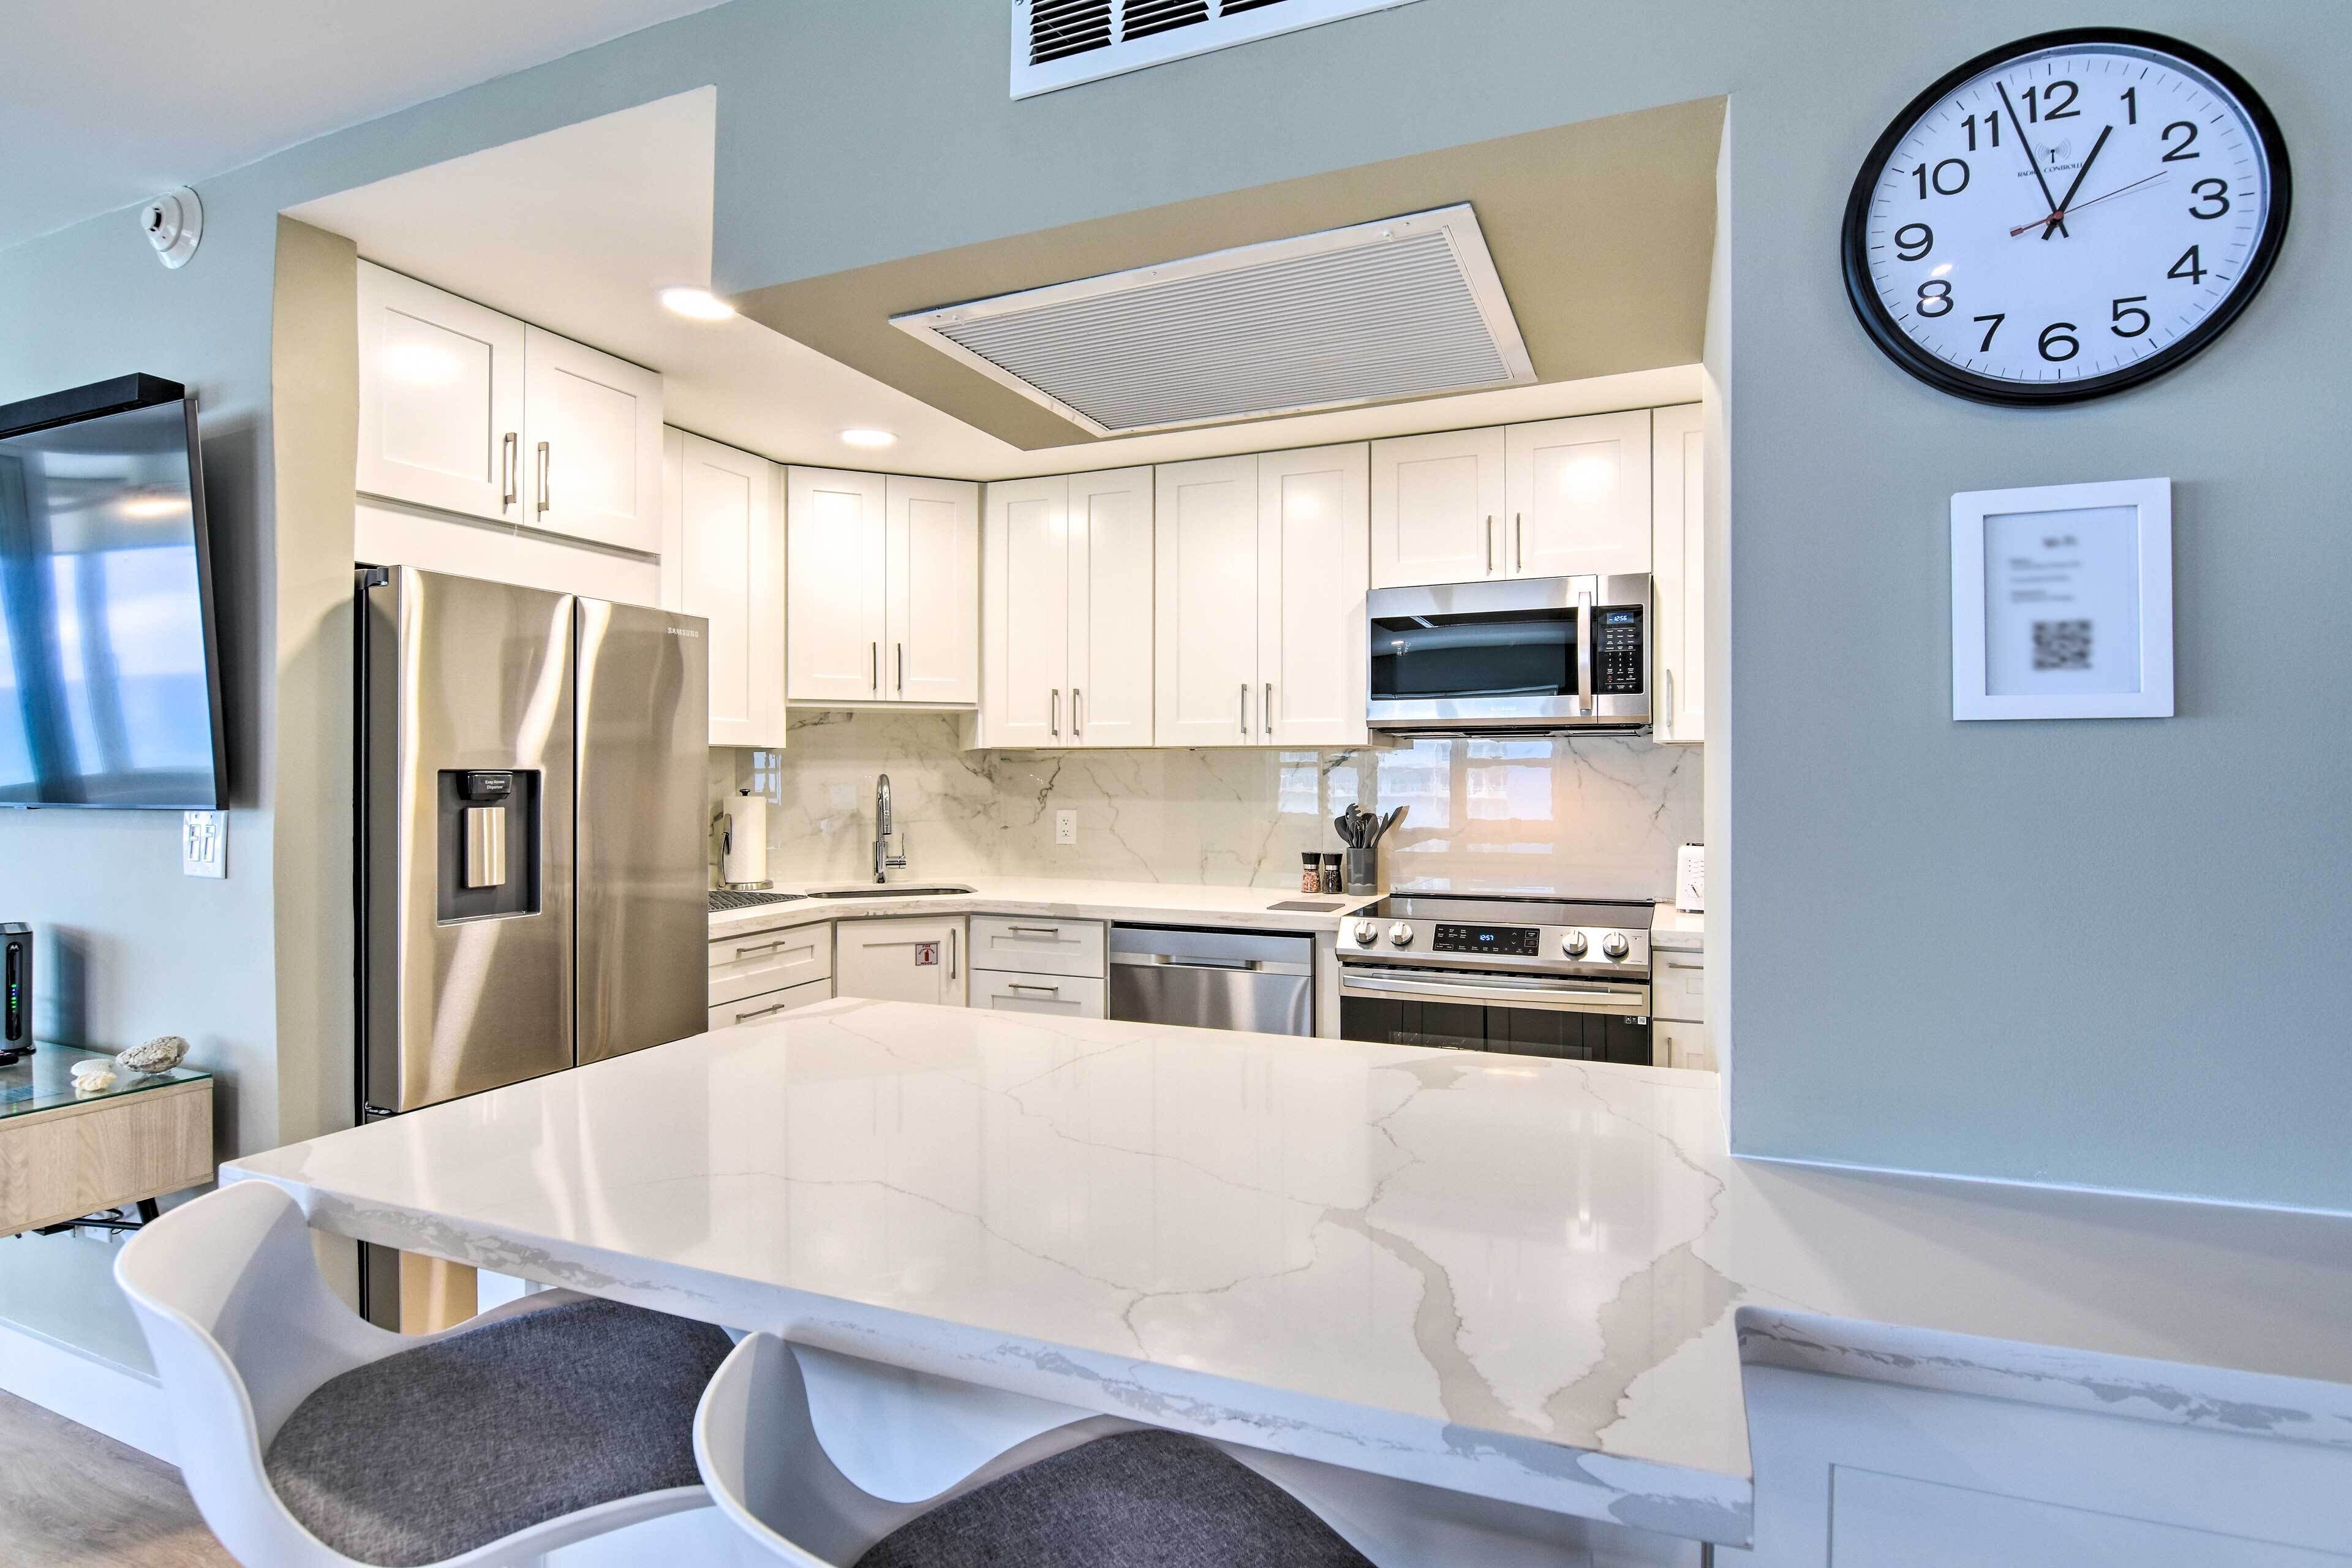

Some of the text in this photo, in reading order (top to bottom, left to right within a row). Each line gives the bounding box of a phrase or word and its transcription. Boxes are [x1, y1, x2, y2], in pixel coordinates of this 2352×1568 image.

[2021, 80, 2081, 124] 12
[2120, 86, 2136, 125] 1
[1961, 110, 1999, 151] 11
[2161, 121, 2200, 163] 2
[1912, 158, 1970, 200] 10
[2188, 178, 2230, 220] 3
[1894, 223, 1934, 262] 9
[2167, 244, 2207, 285] 4
[1916, 279, 1954, 318] 8
[2110, 295, 2150, 338] 5
[1973, 313, 2005, 353] 7
[2038, 322, 2079, 362] 6
[668, 627, 699, 638] SAMSUNG
